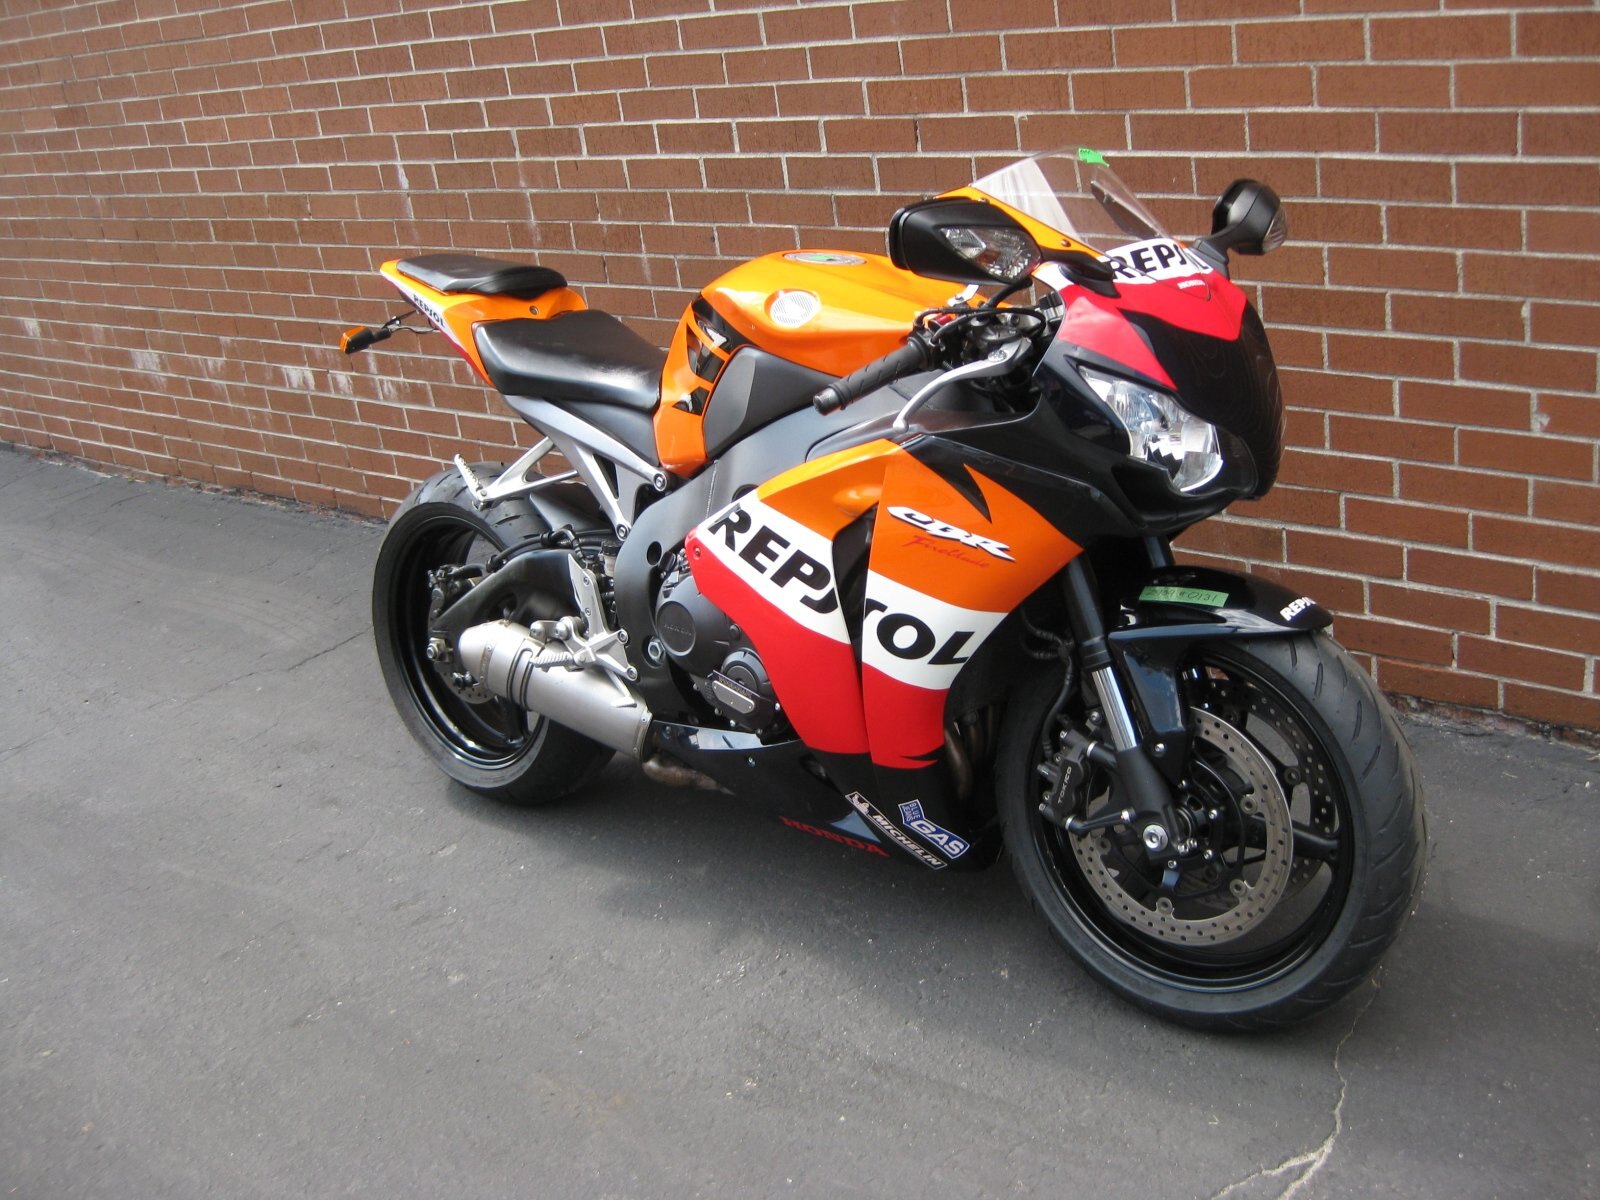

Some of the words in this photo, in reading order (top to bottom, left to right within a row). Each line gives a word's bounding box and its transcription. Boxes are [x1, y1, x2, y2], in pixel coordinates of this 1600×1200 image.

[413, 293, 445, 328] REPSOL
[887, 506, 1016, 564] CBR
[1057, 766, 1072, 804] TOKICO
[909, 803, 920, 819] BLUE
[778, 815, 890, 858] HONDA
[872, 814, 942, 866] MICHELIN
[910, 820, 965, 855] GAS
